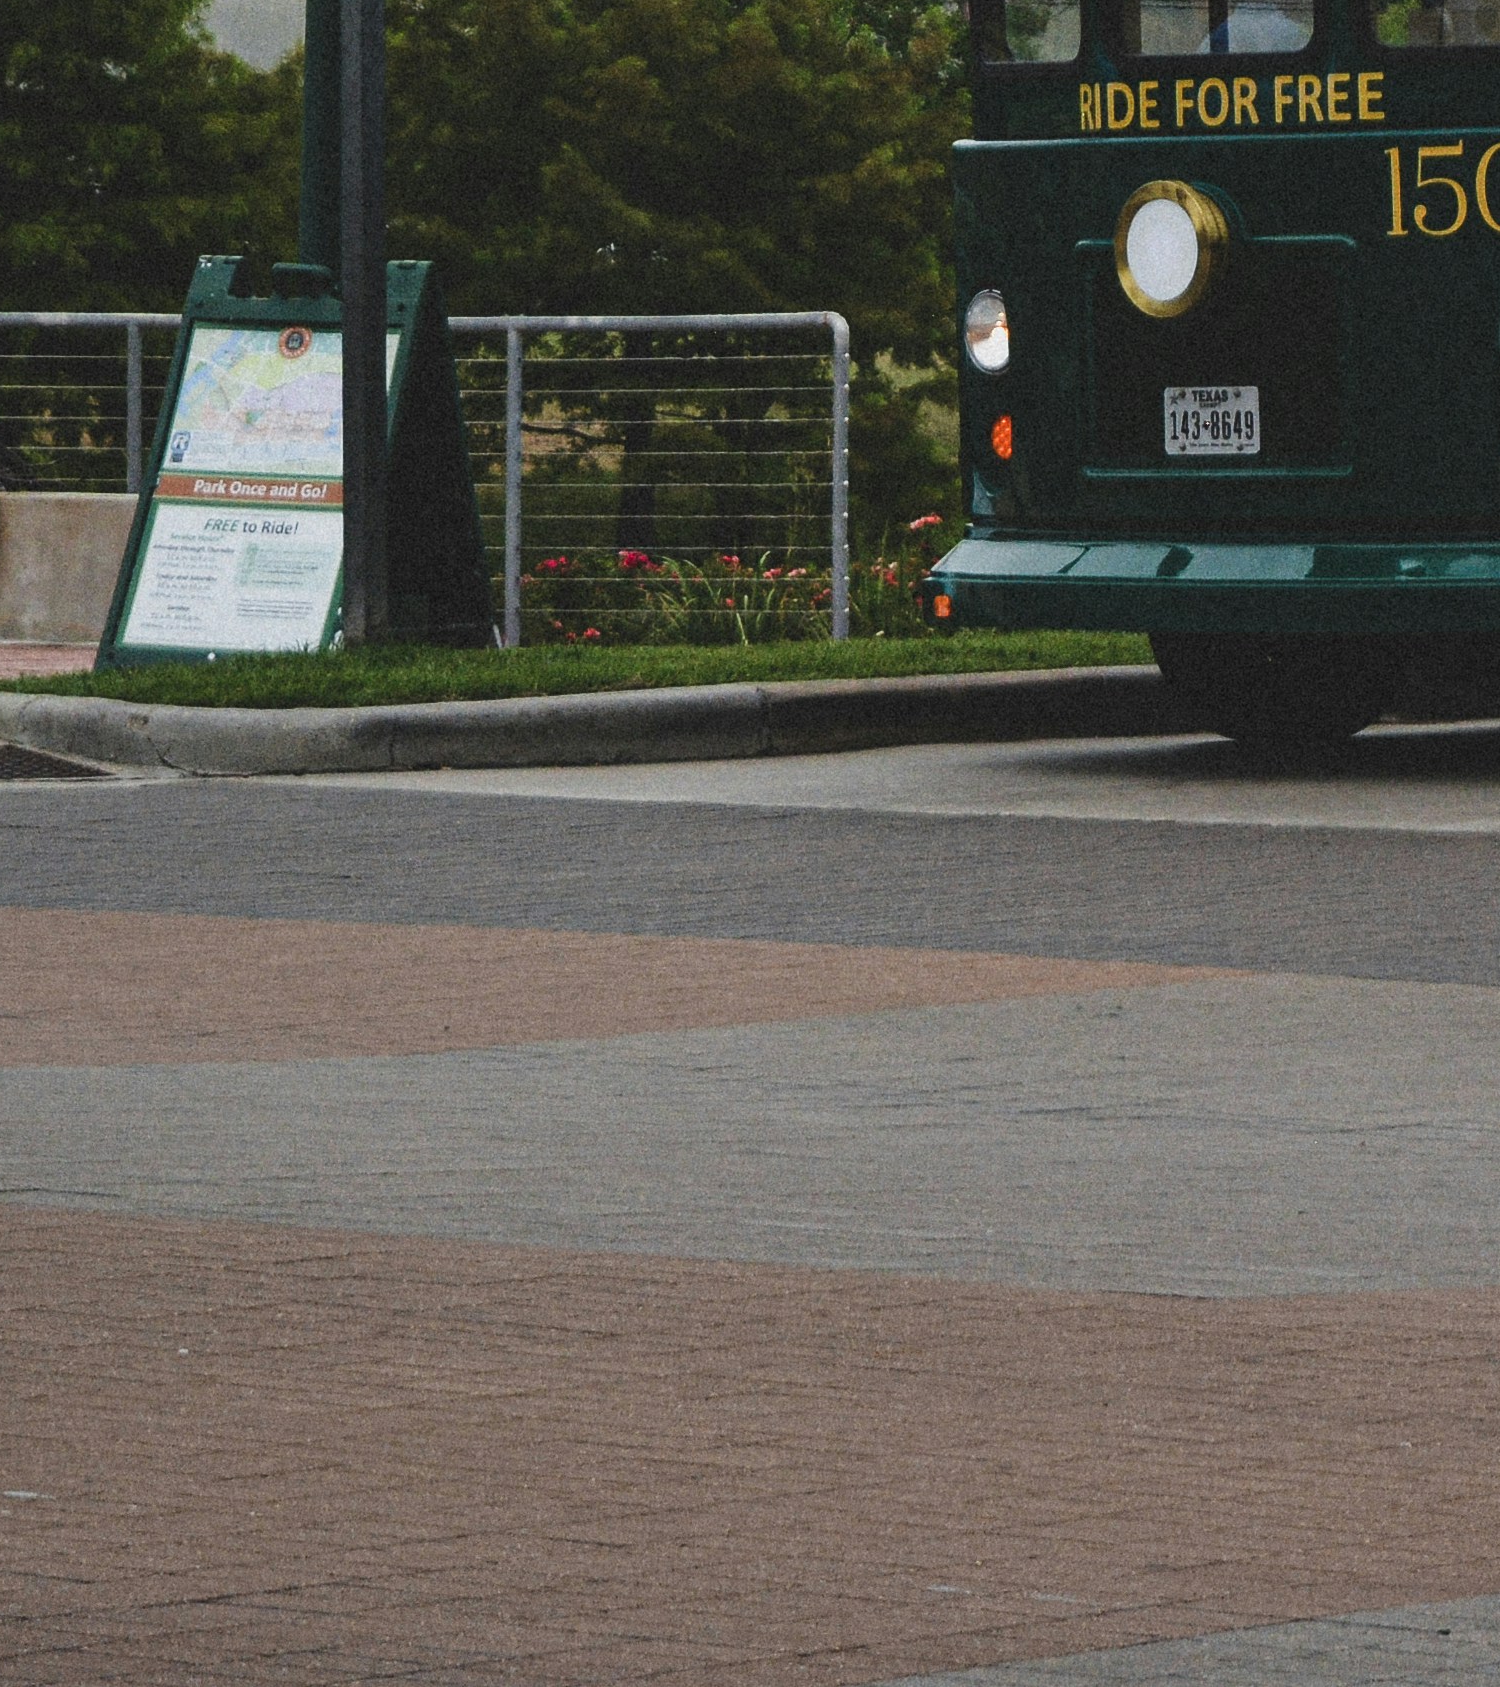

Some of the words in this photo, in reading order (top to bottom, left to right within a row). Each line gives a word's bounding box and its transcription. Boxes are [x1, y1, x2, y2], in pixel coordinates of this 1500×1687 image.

[1079, 78, 1160, 131] RIDE
[1174, 76, 1260, 128] FOR
[1273, 71, 1386, 125] FREE
[1191, 389, 1229, 403] TEXAS
[193, 479, 226, 494] Park
[230, 481, 266, 496] Once
[270, 482, 298, 497] and
[301, 483, 327, 498] Go!
[203, 518, 240, 532] FREE
[242, 521, 257, 534] to
[261, 521, 300, 536] Ride!
